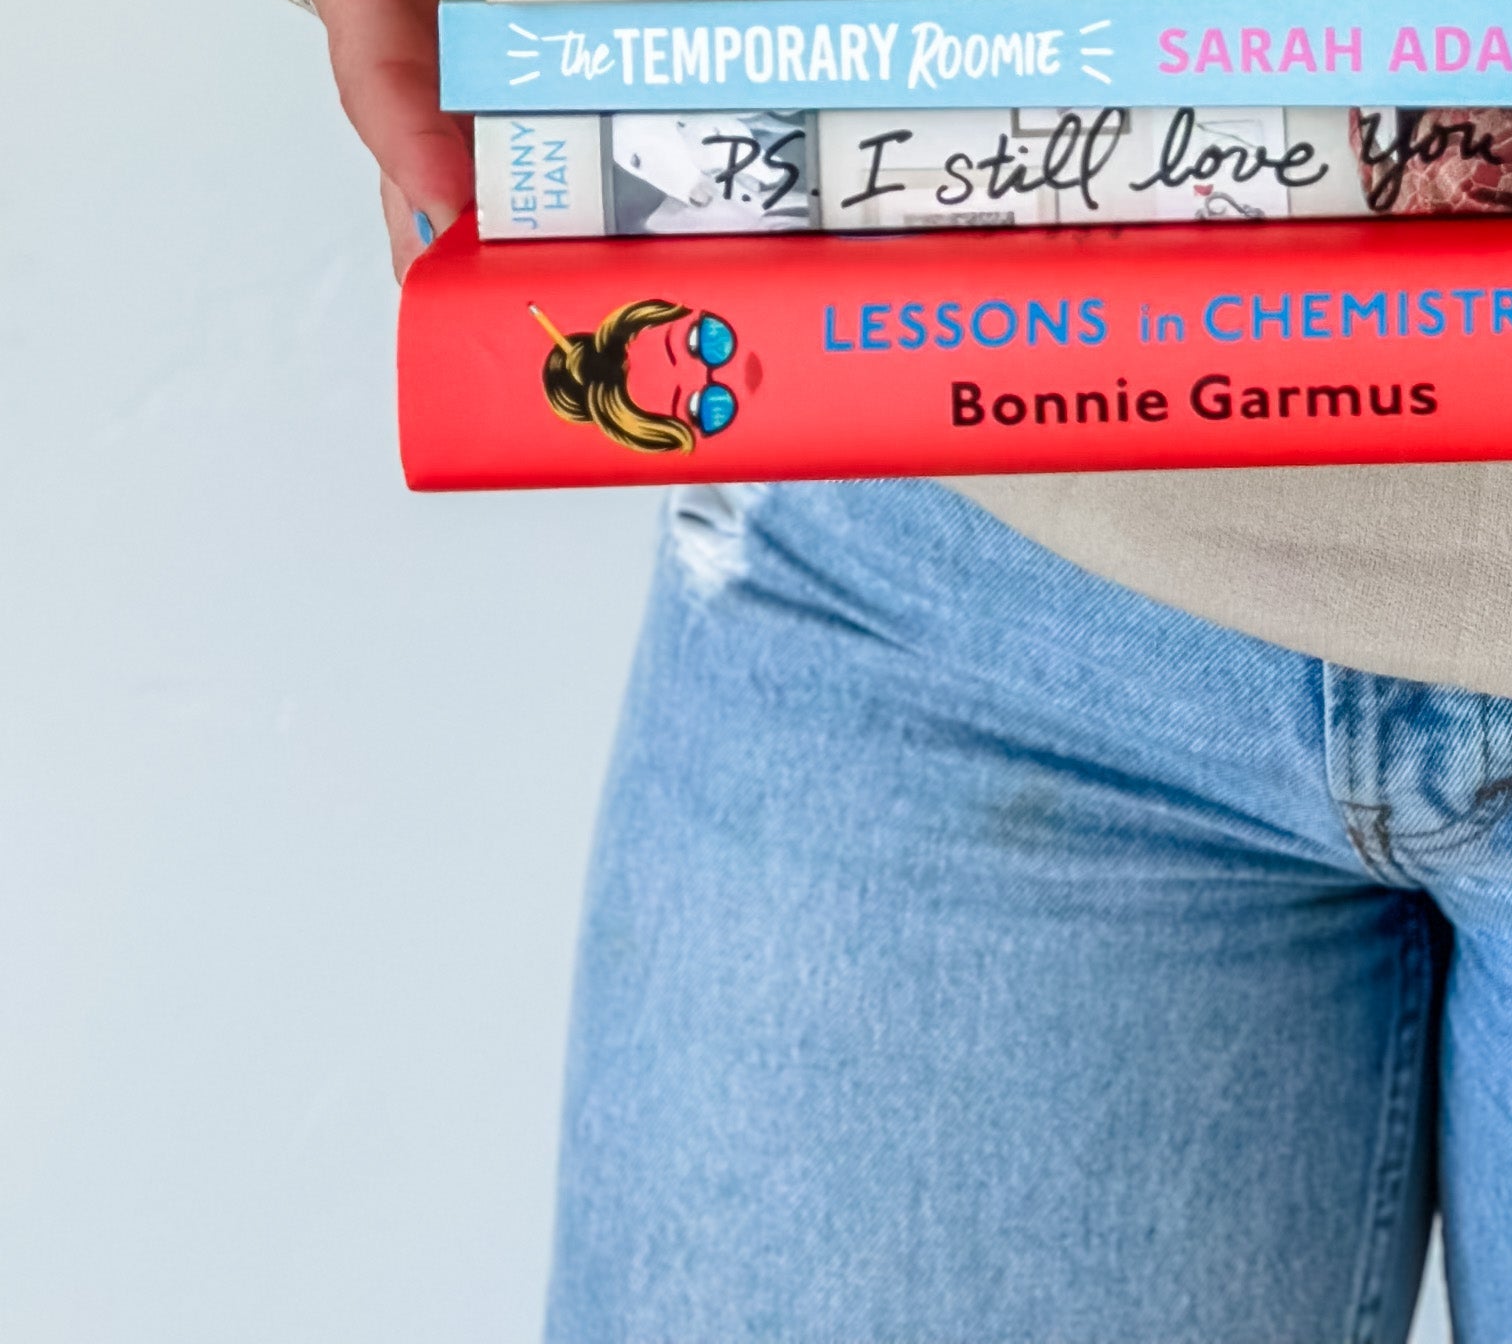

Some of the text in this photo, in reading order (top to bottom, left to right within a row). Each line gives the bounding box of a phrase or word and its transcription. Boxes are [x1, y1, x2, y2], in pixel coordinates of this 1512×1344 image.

[538, 29, 615, 80] the
[614, 23, 898, 85] TEMPORARY
[1158, 27, 1363, 74] SARAH
[511, 121, 538, 229] JENNY
[544, 140, 568, 209] HAN
[841, 129, 913, 209] I
[936, 108, 1126, 210] still
[1130, 108, 1329, 190] love
[1359, 111, 1504, 212] you
[824, 296, 1109, 351] LESSONS
[1139, 302, 1184, 343] in
[950, 375, 1438, 427] Bonnie Garmus
